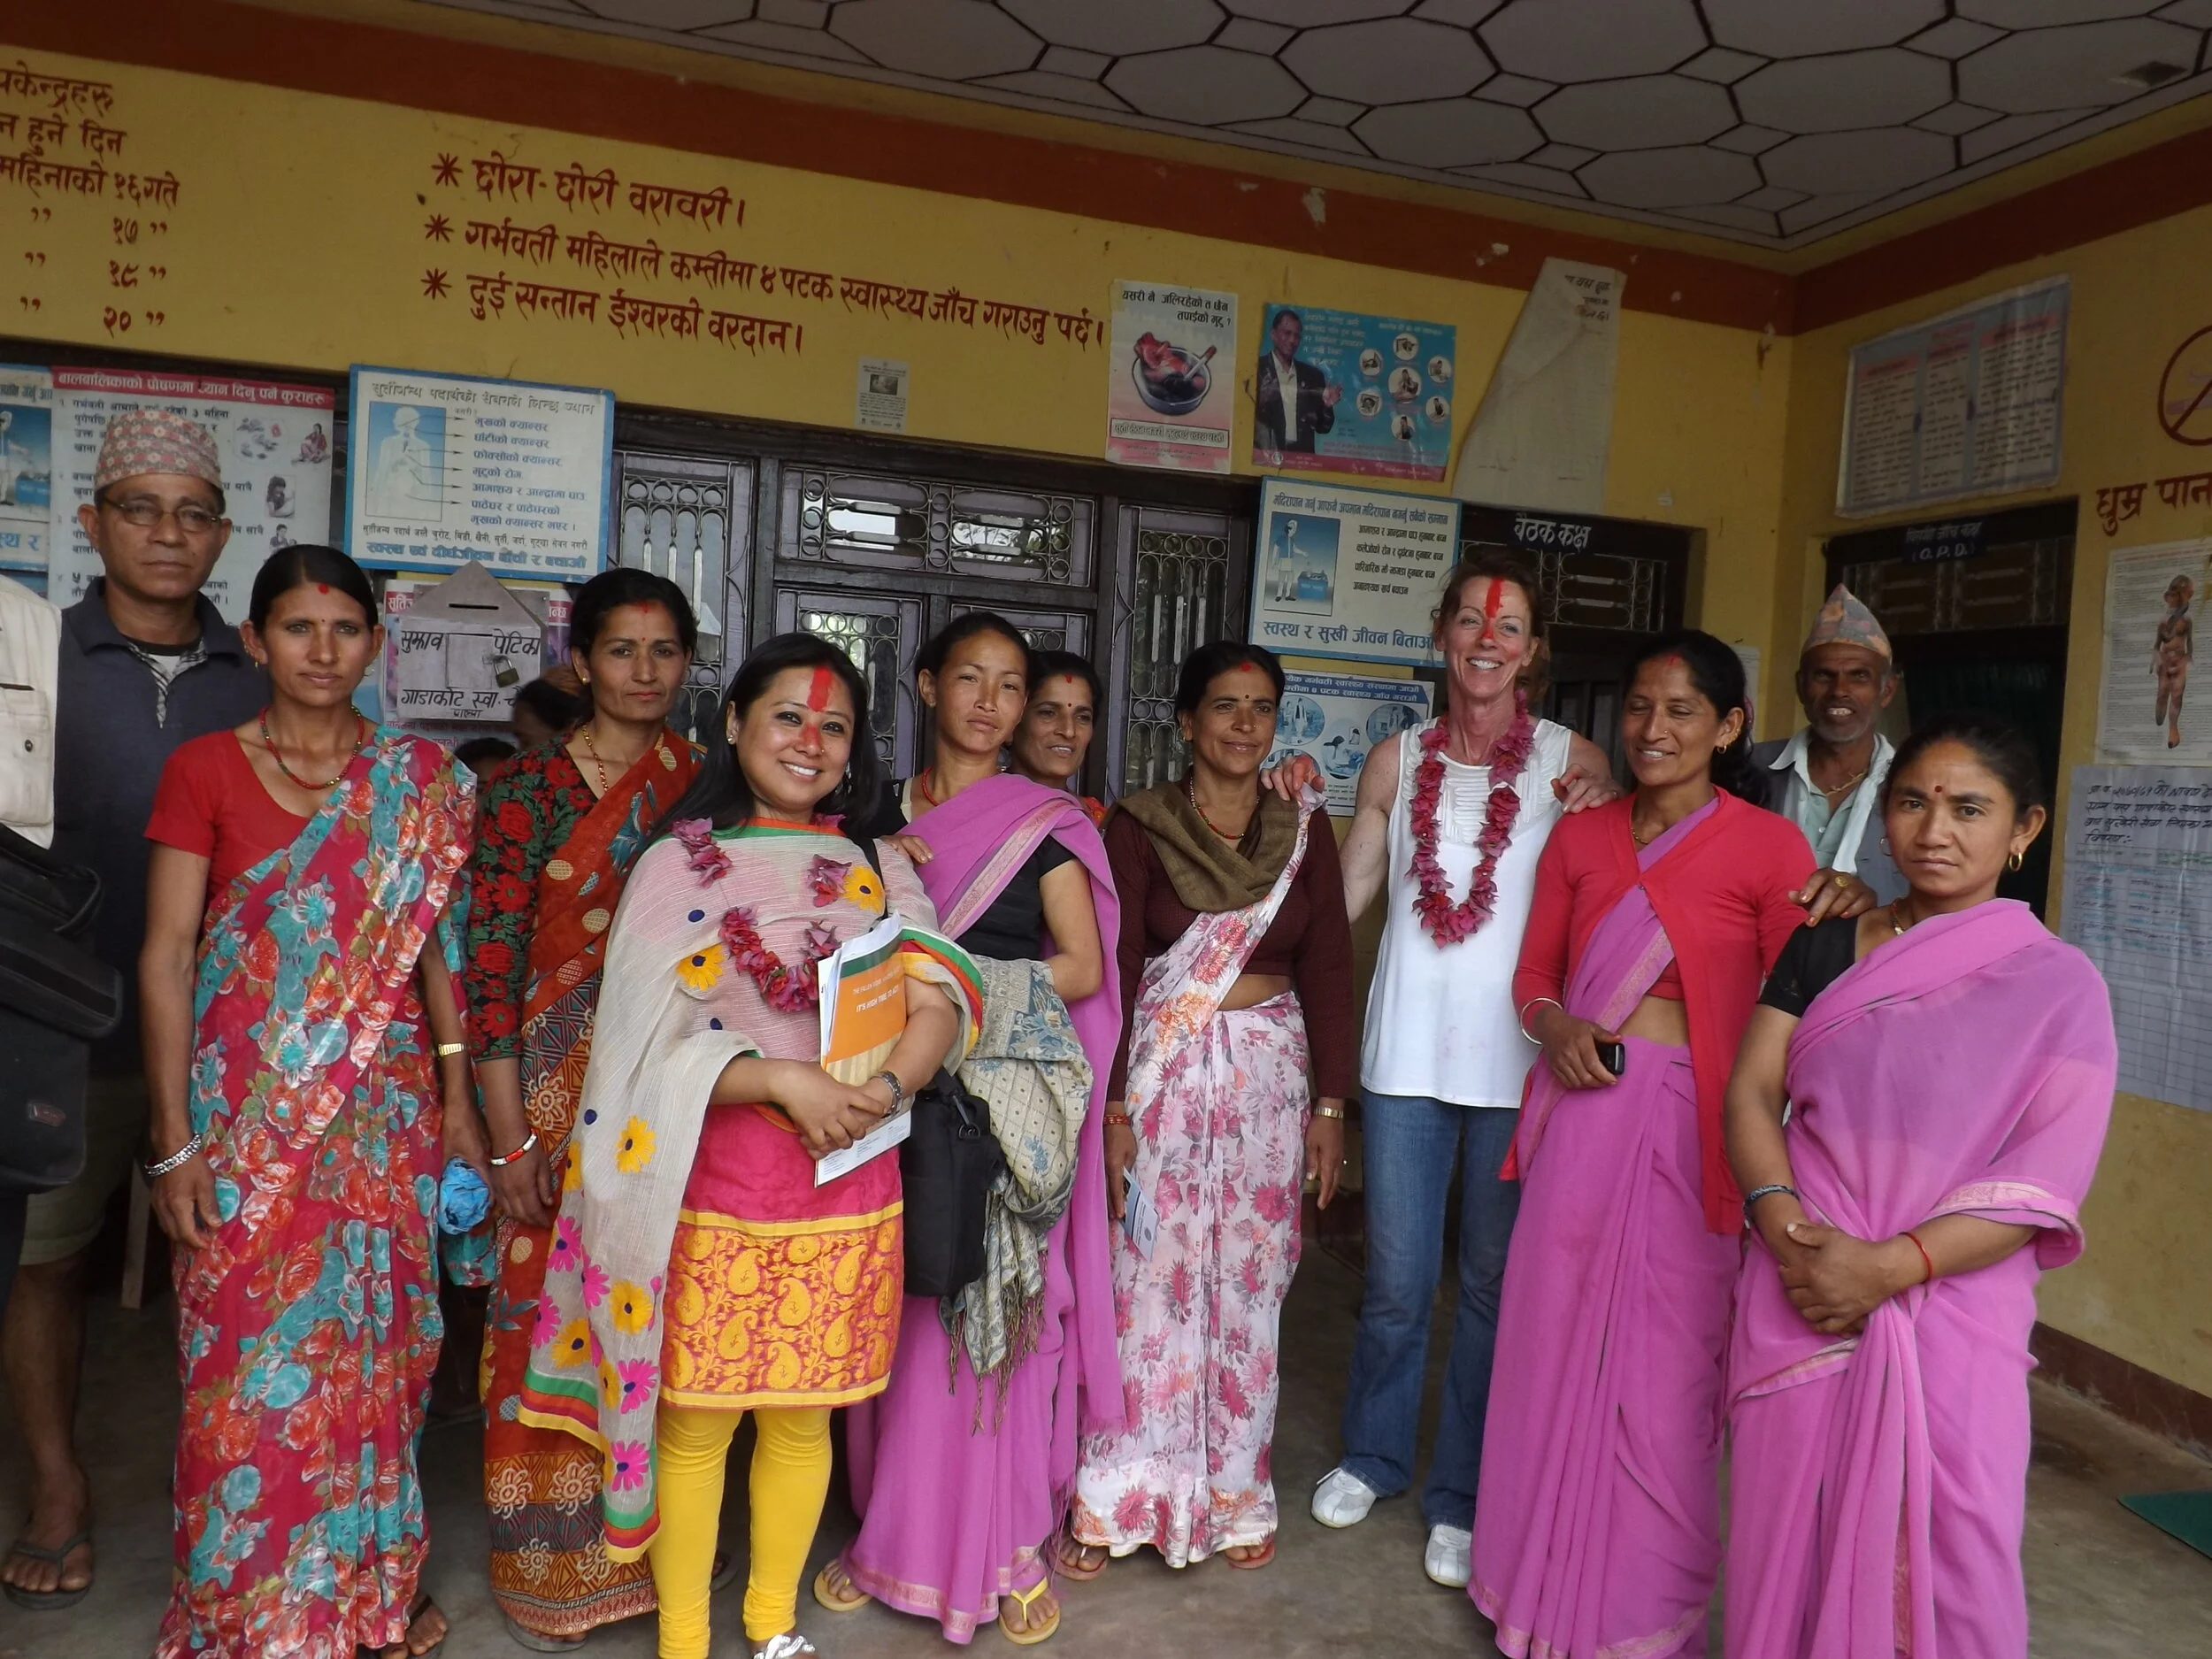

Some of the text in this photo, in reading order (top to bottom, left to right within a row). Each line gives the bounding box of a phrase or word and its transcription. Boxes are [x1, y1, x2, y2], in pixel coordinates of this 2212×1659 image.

[28, 112, 68, 157] हुने
[79, 119, 127, 162] दिन
[0, 152, 108, 198] महिनाको
[465, 218, 559, 266] गर्भवती
[566, 230, 664, 282] महिलाले
[670, 250, 757, 292] कम्तीमा
[780, 267, 833, 302] पटक
[840, 277, 929, 320] स्वास्थ्य
[928, 287, 979, 329] जाँच
[983, 300, 1050, 346] गराउनु
[1122, 288, 1145, 301] यसरी
[516, 281, 600, 323] सन्तान
[104, 306, 132, 338] २०
[147, 377, 193, 395] पोषणमा
[232, 382, 256, 401] दिनु
[475, 417, 506, 428] मुखको
[493, 628, 540, 655] पेटिका
[1263, 621, 1389, 645] स्वस्थ र सुखी जीवन
[401, 687, 465, 708] गाडाकोट
